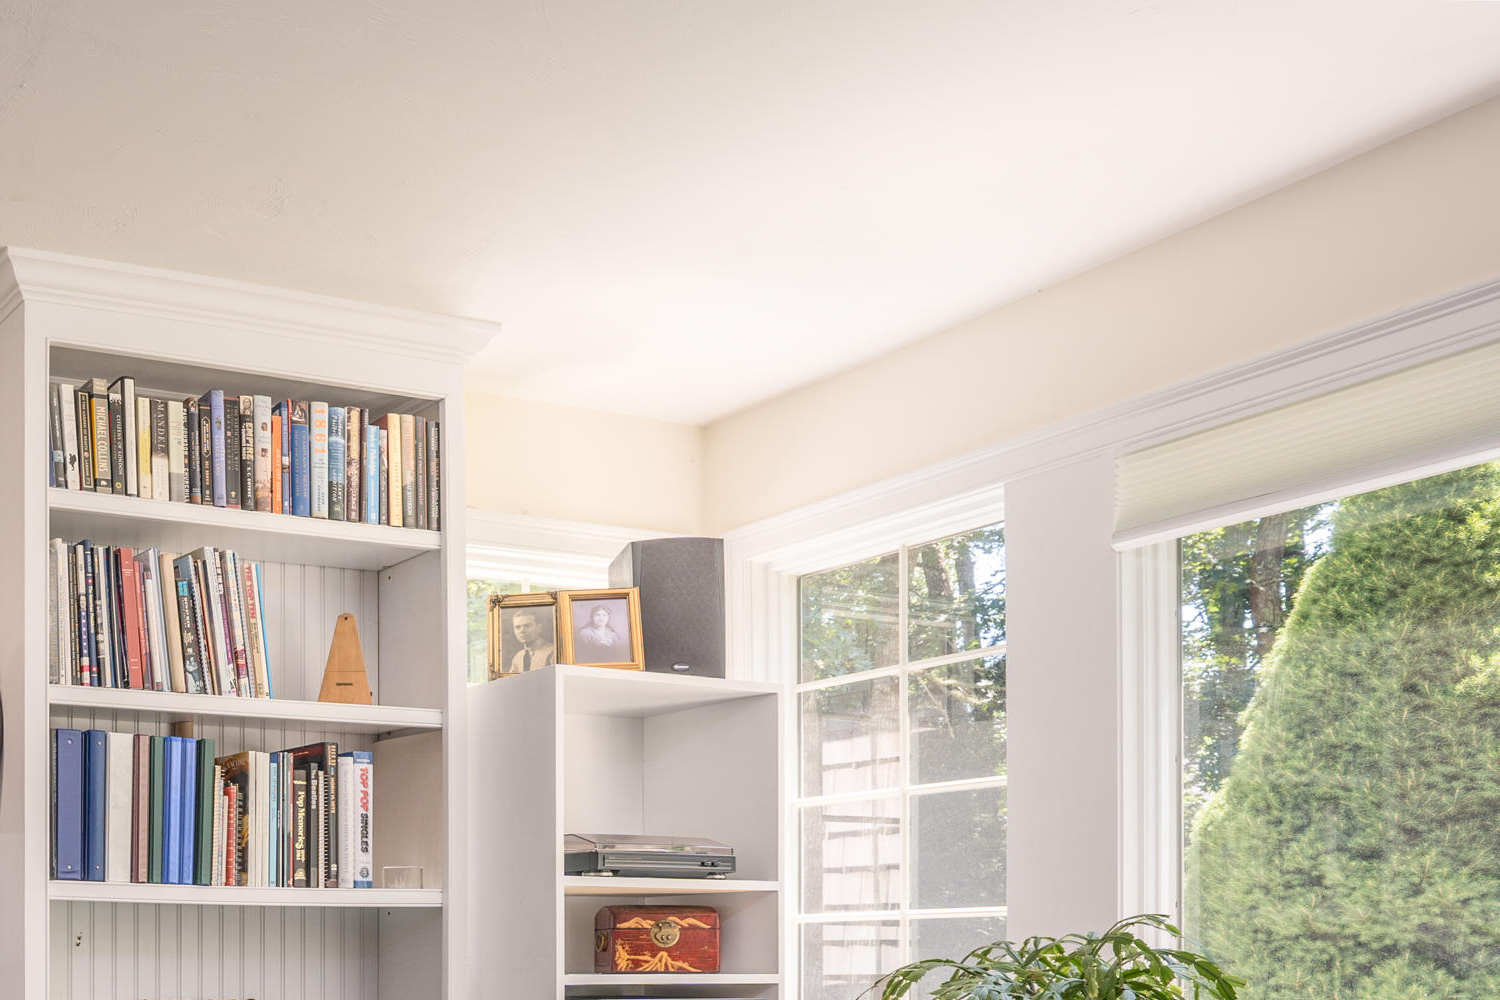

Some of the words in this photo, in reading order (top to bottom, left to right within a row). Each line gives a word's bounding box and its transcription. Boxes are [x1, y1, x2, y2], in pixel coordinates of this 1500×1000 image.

[96, 406, 107, 438] MICHAEL
[157, 404, 165, 457] MANDELA
[314, 407, 327, 456] 1861
[98, 441, 108, 472] COLLINS
[117, 441, 122, 449] OF
[360, 767, 368, 788] TOP
[296, 792, 305, 806] Pop
[360, 790, 369, 812] POP
[295, 808, 306, 849] Memories
[360, 813, 369, 854] SINGLES
